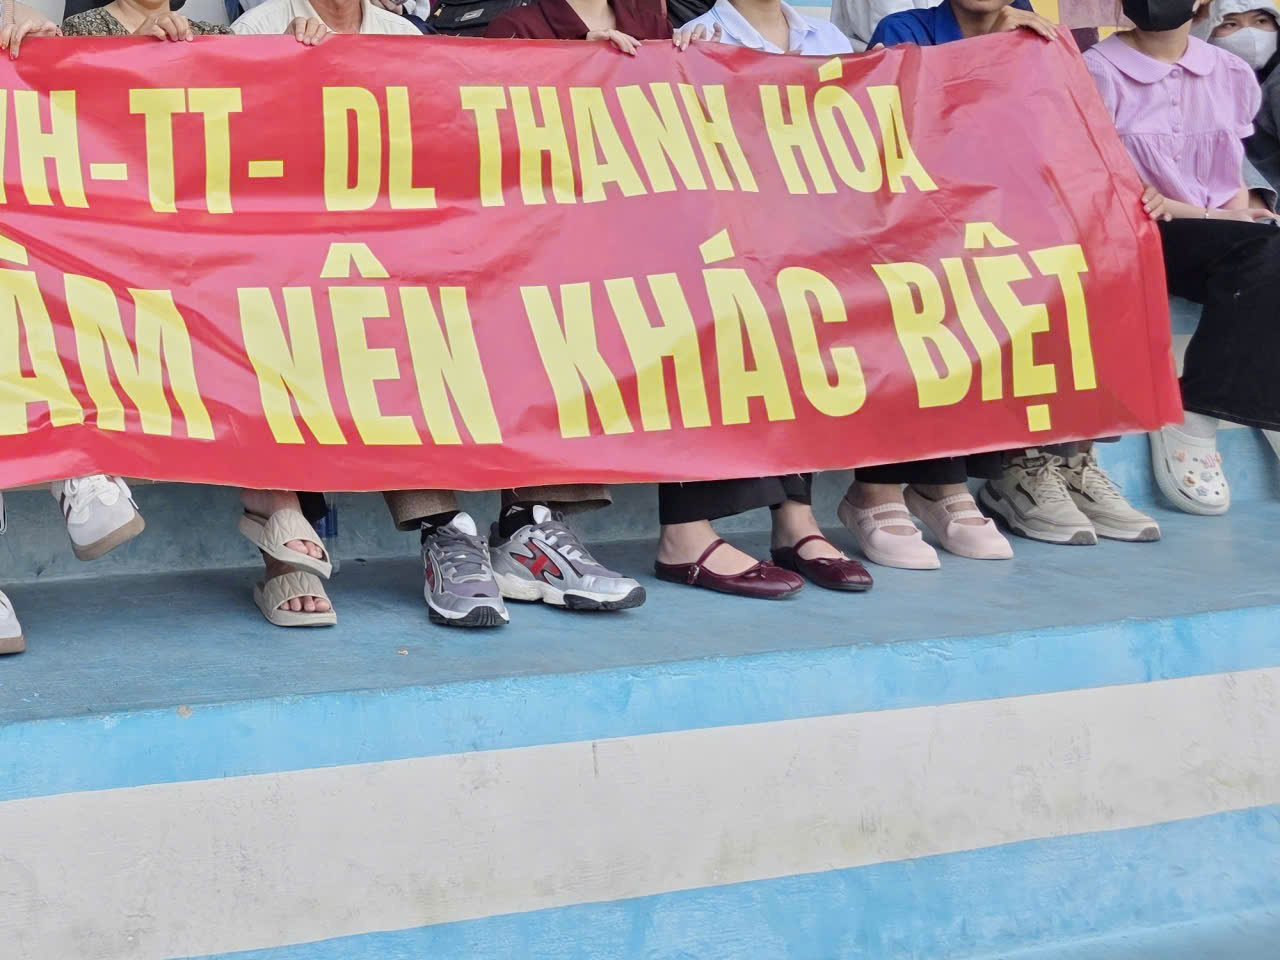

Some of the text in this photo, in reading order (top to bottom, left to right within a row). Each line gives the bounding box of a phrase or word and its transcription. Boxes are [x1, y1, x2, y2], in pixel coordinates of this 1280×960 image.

[322, 85, 436, 211] DL
[460, 82, 757, 207] THANH
[759, 57, 938, 196] HÓA
[238, 243, 502, 446] NÊN
[521, 230, 867, 439] KHÁC
[871, 221, 1098, 432] BIỆT
